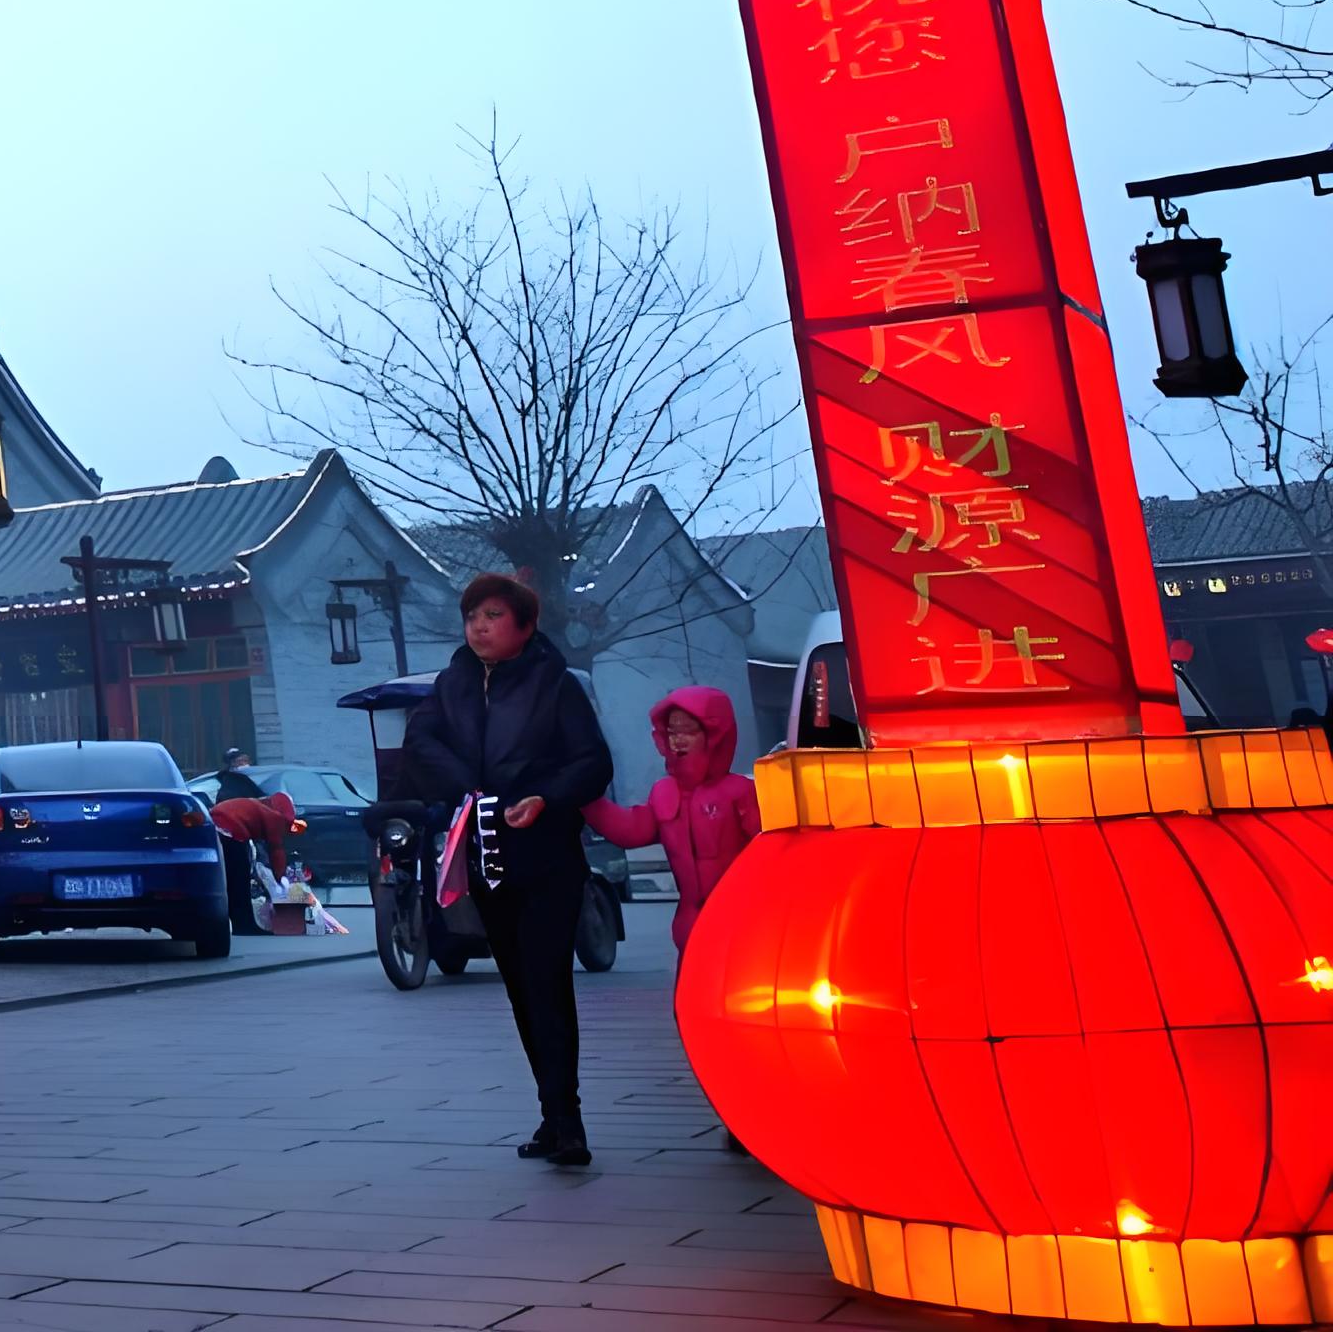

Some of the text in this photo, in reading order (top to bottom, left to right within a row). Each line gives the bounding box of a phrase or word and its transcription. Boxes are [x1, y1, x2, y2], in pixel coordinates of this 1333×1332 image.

[834, 114, 1012, 385] 户纳春风
[877, 410, 1071, 697] 财源广进
